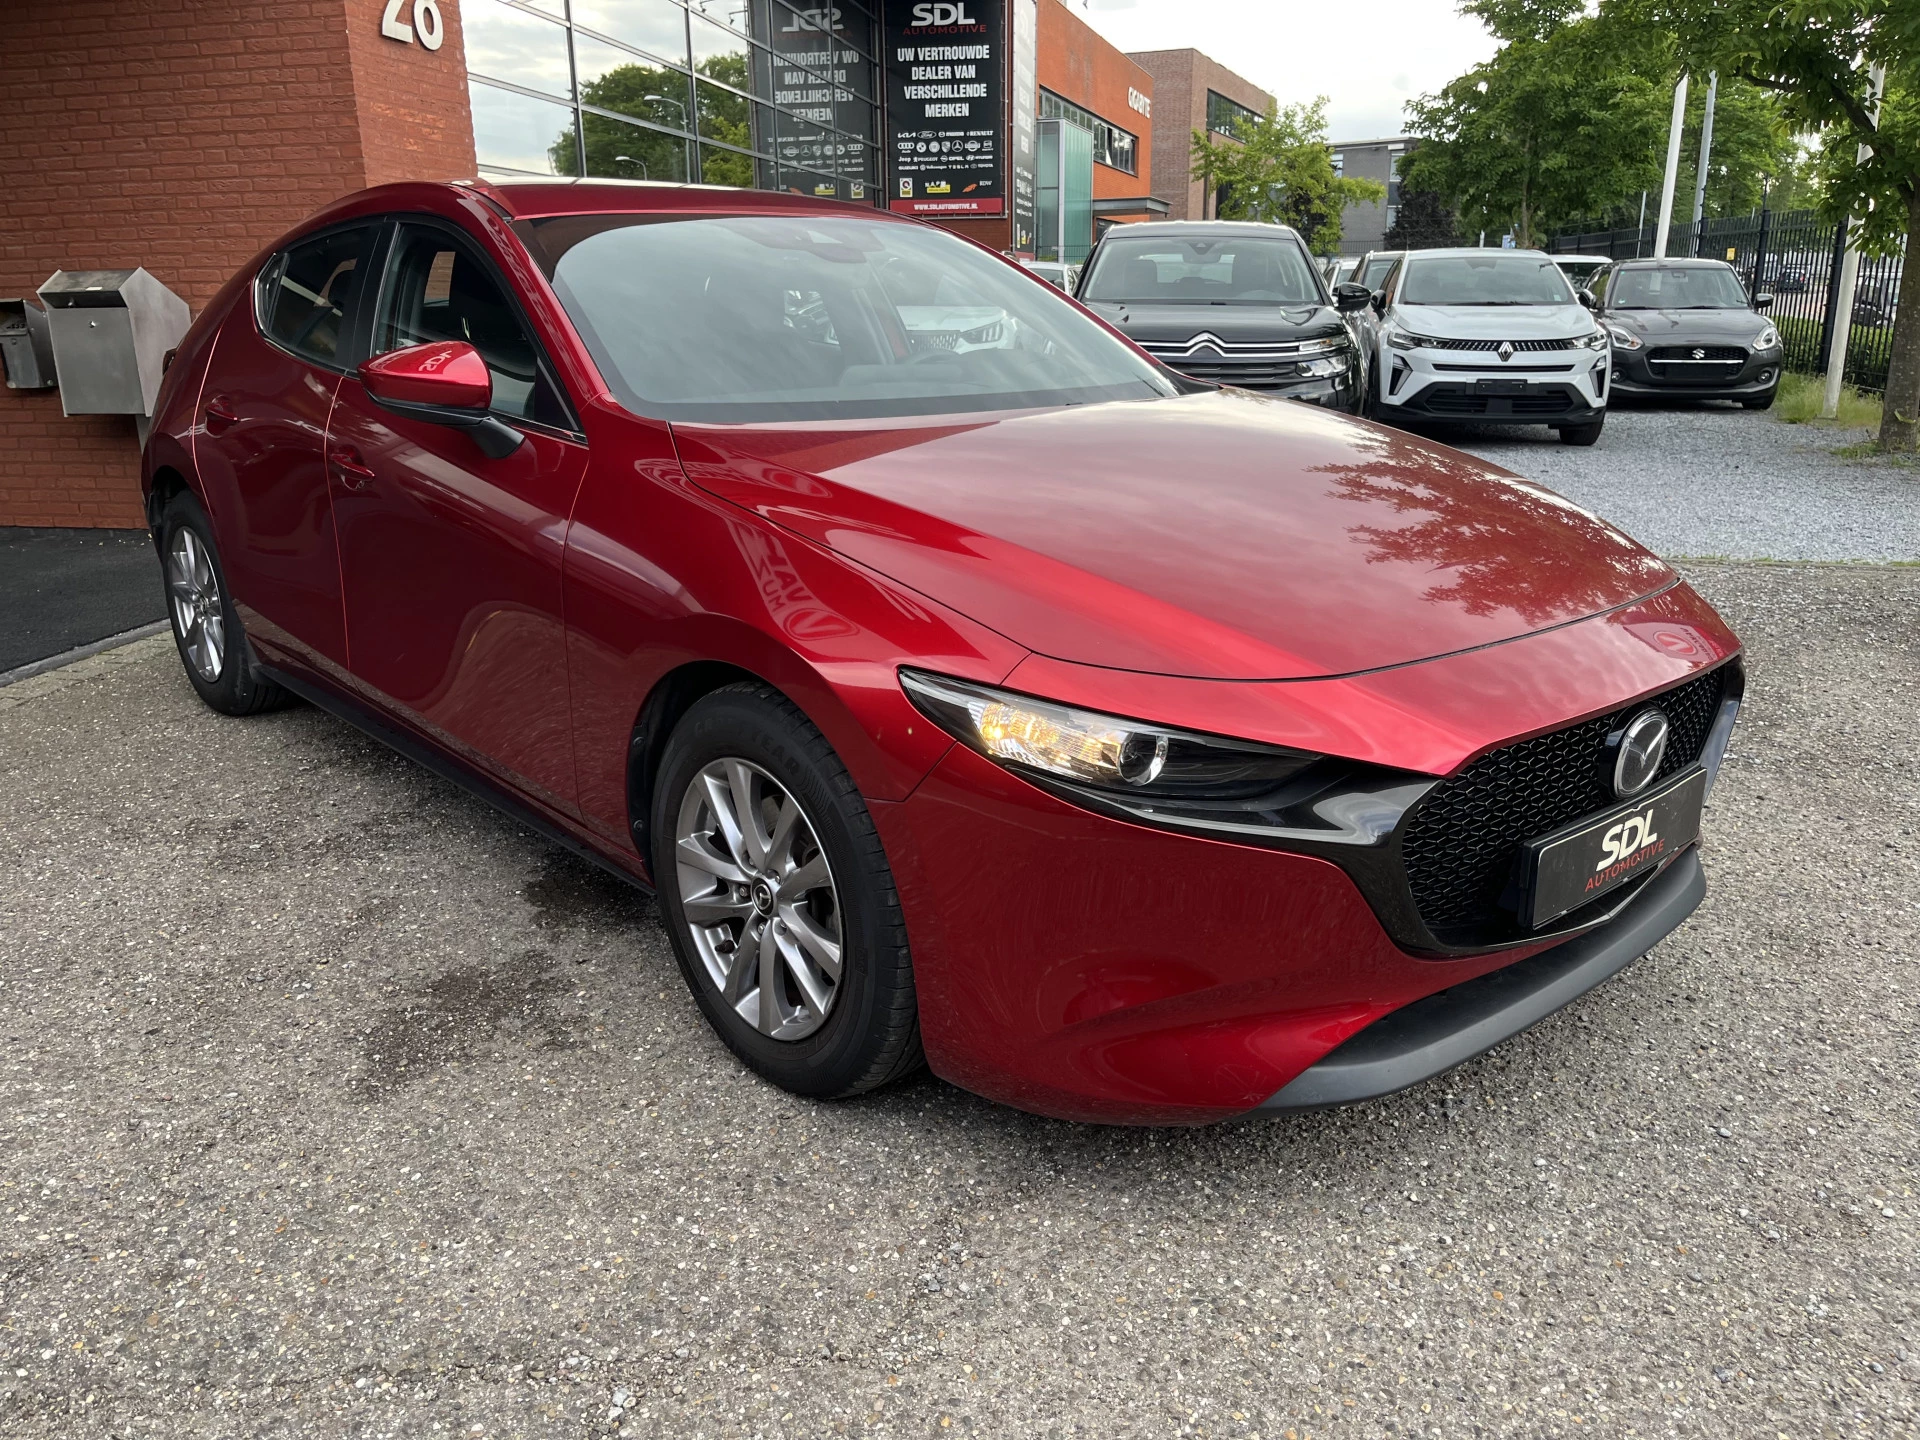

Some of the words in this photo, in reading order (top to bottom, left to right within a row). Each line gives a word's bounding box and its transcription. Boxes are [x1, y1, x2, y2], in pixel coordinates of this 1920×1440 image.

[910, 2, 976, 27] SDL
[902, 24, 987, 36] AUTOMOTIVE
[897, 47, 915, 62] UW
[917, 44, 990, 61] VERTROUWDE
[911, 66, 952, 80] DEALER
[954, 64, 976, 79] VAN
[903, 83, 988, 100] VERSCHILLENDE
[925, 103, 969, 117] MERKEN
[1595, 808, 1658, 872] SDL
[1584, 838, 1665, 893] AUTOMOTIVE
